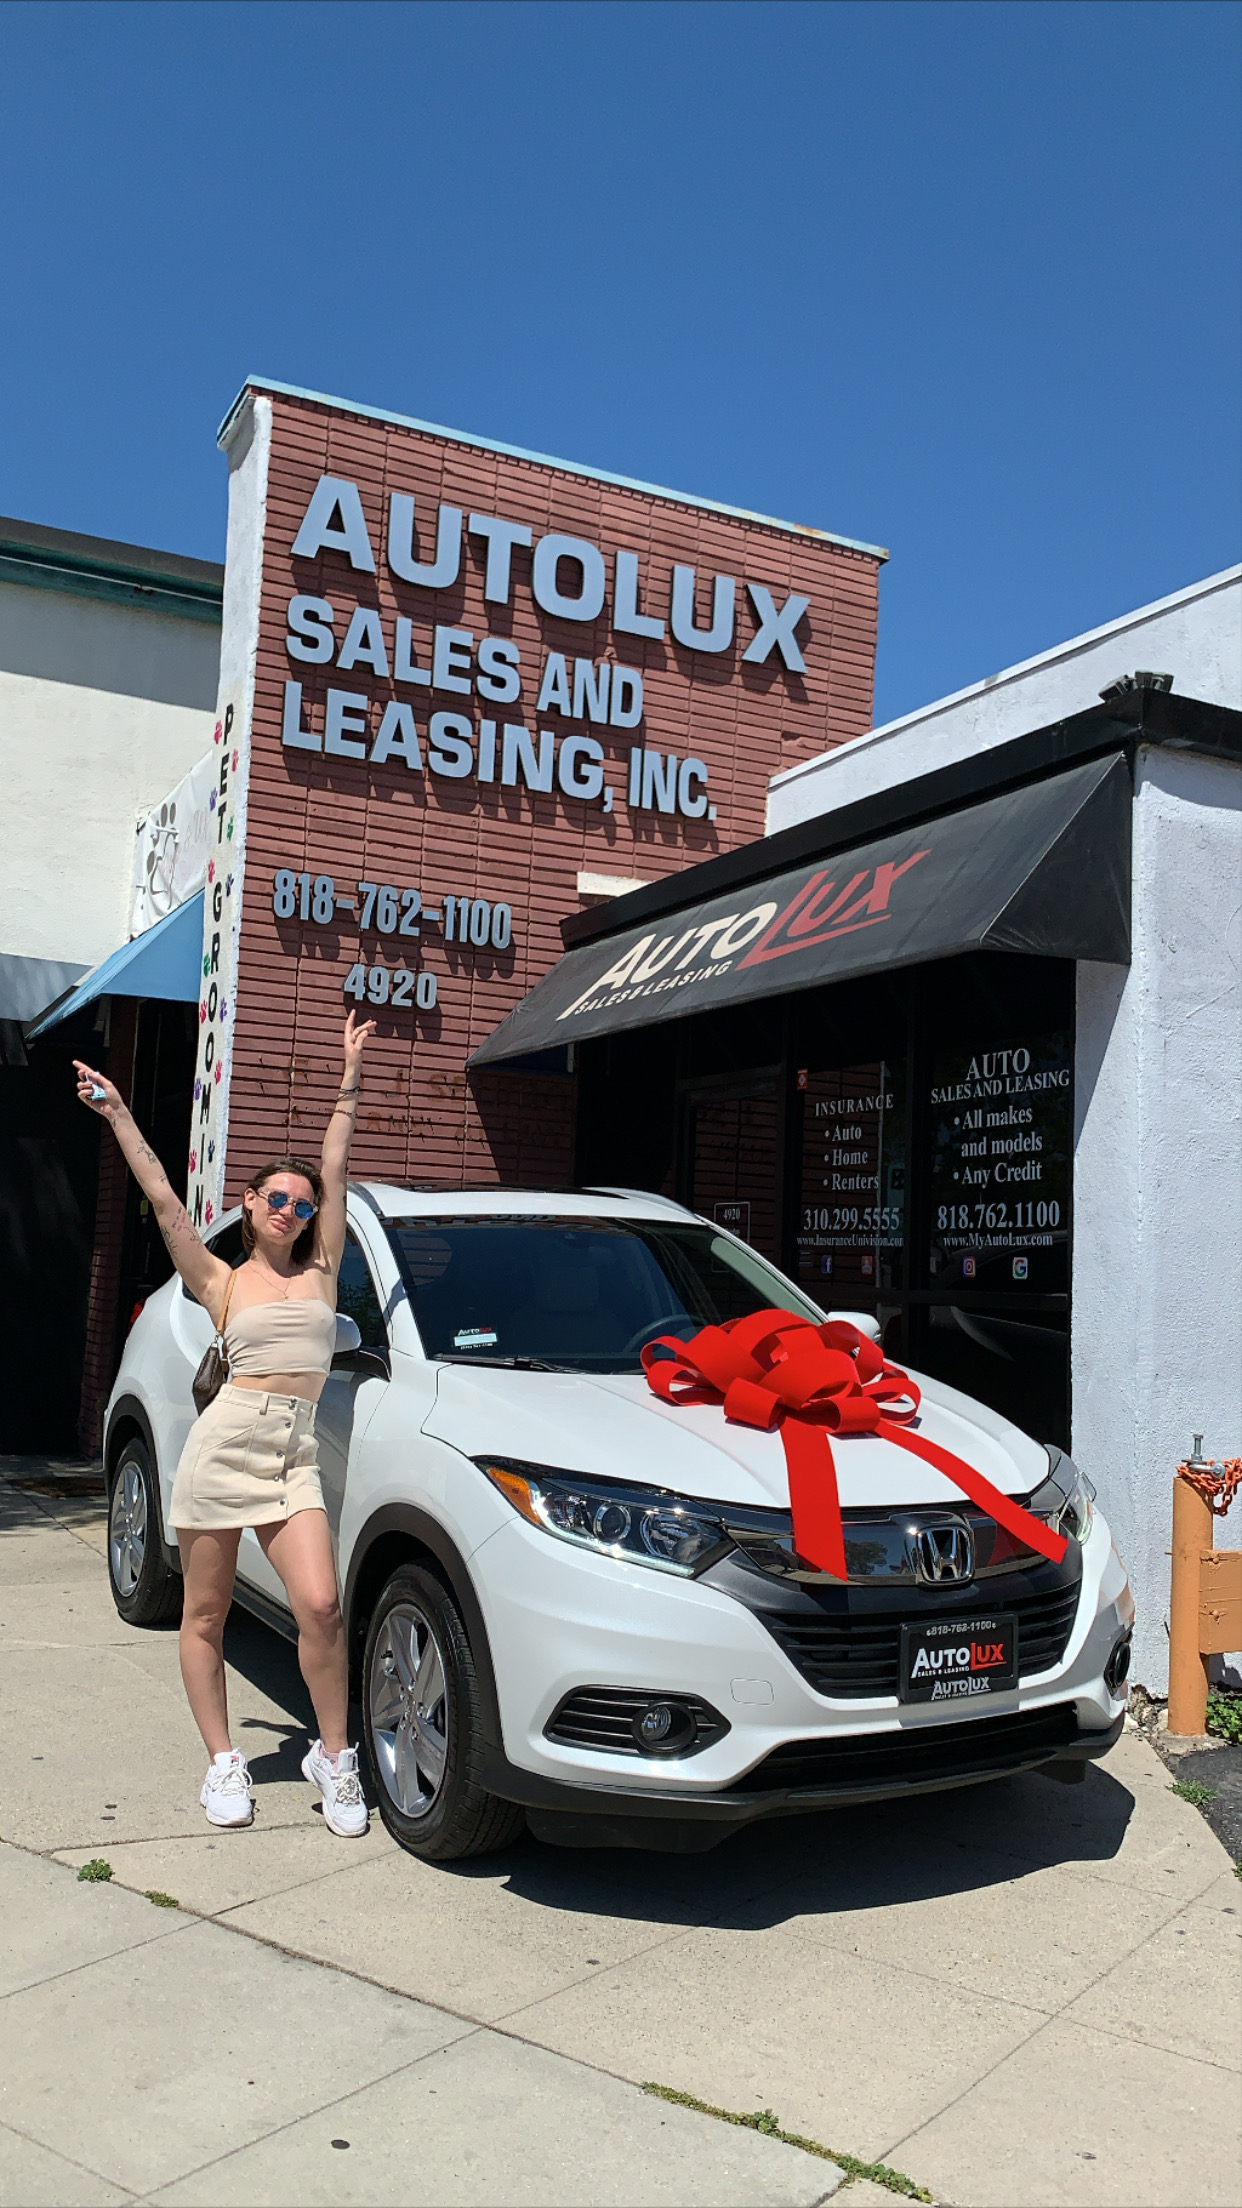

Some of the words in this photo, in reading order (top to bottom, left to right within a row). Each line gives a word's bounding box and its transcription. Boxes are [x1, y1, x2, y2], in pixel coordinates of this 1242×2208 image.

[290, 473, 811, 674] AUTOLUX
[286, 594, 521, 703] SALES
[536, 652, 643, 729] AND
[281, 680, 613, 813] LEASING,
[628, 746, 717, 821] INC.
[217, 703, 234, 845] PET
[273, 868, 512, 950] 818-762-1100
[343, 963, 438, 1010] 4920
[193, 881, 223, 1229] GROOMIN
[965, 1048, 1031, 1081] AUTO
[930, 1084, 972, 1104] SALES
[973, 1079, 1003, 1098] AND
[1005, 1069, 1070, 1094] LEASING
[814, 1093, 894, 1117] INSURANCE
[962, 1108, 983, 1130] All
[986, 1105, 1033, 1127] makes
[832, 1124, 862, 1142] Auto
[961, 1136, 987, 1157] and
[991, 1131, 1043, 1154] models
[832, 1148, 868, 1166] Home
[831, 1172, 880, 1191] Renters
[961, 1165, 991, 1189] Any
[994, 1160, 1043, 1182] Credit
[723, 1208, 741, 1220] 4920
[803, 1207, 900, 1231] 310.299.5555
[937, 1200, 1060, 1230] 818.762.1100
[943, 1232, 1054, 1250] www.MyAutoLux.com
